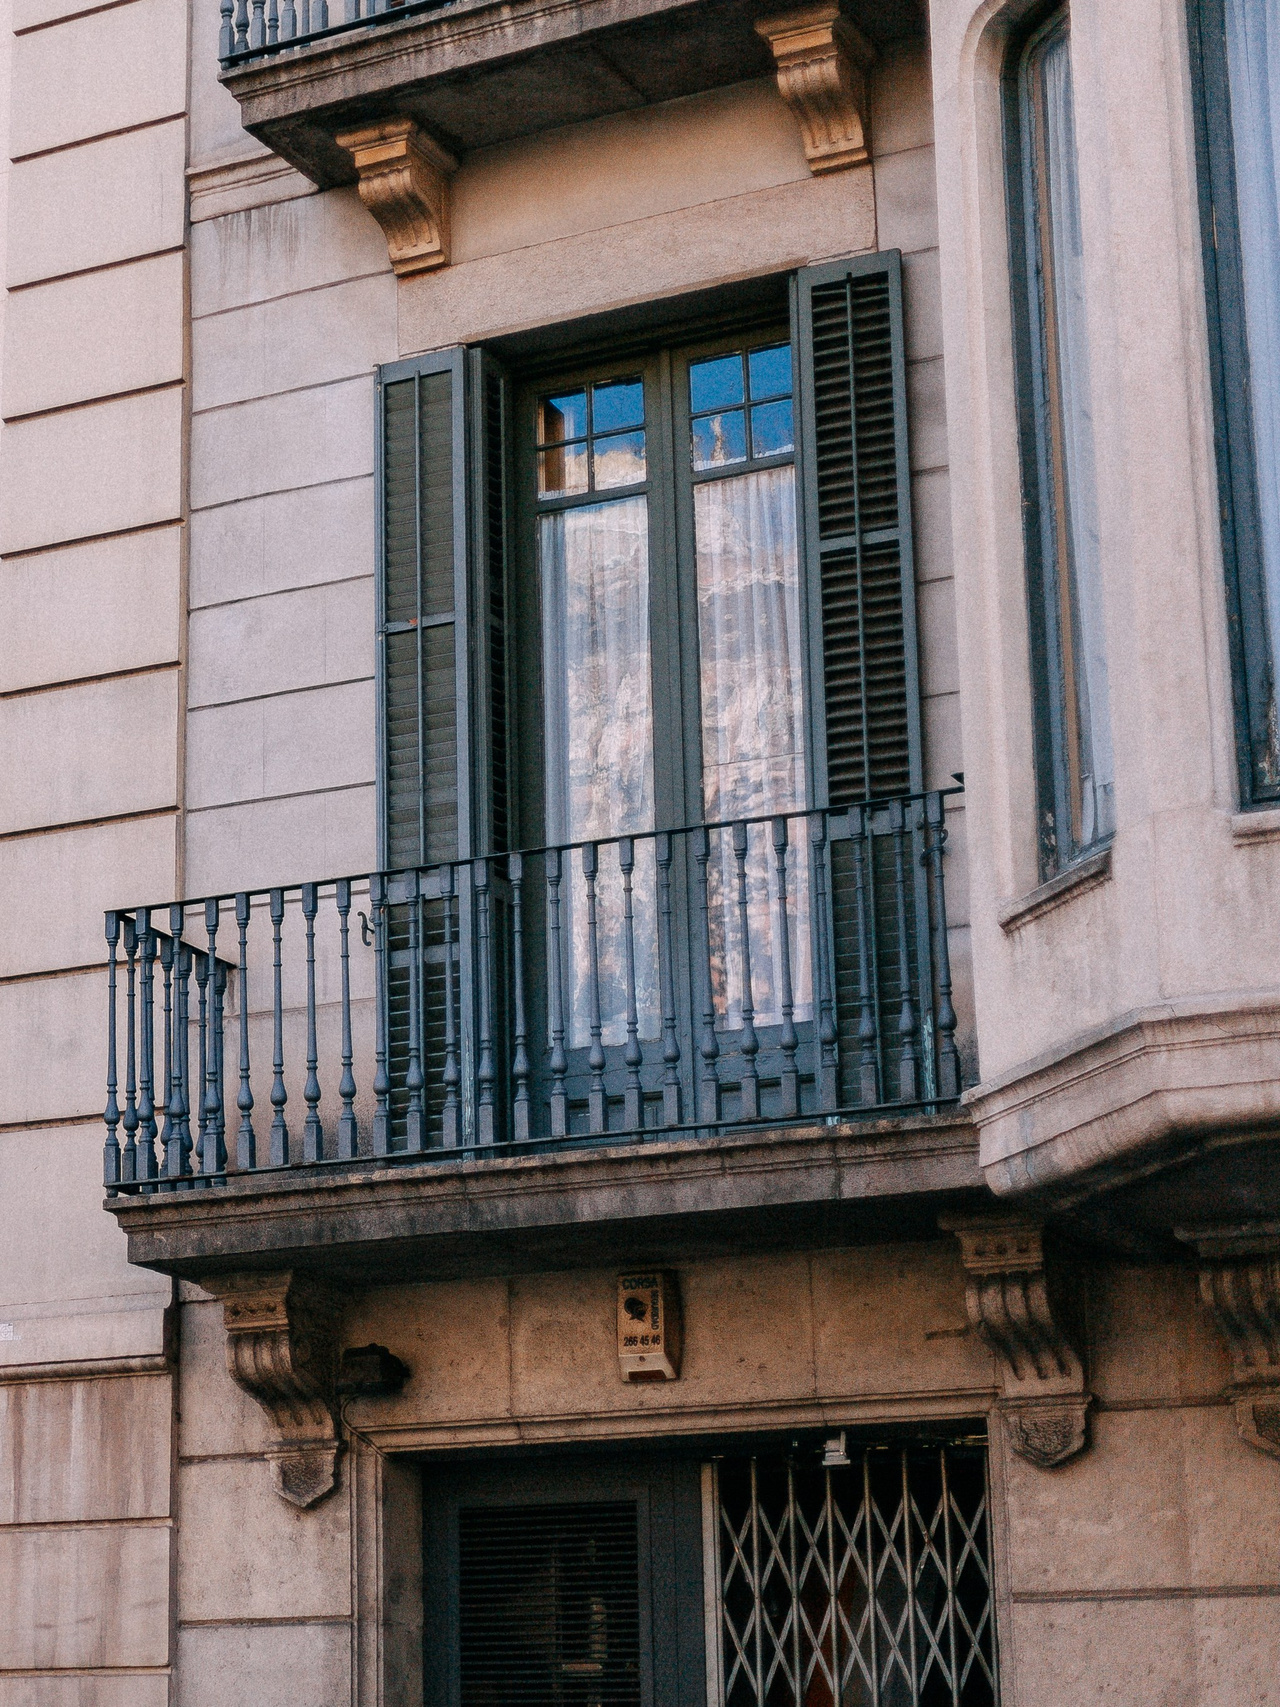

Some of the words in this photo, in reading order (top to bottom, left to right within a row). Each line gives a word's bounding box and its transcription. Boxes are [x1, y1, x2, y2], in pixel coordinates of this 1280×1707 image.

[622, 1278, 658, 1290] CORSA
[624, 1336, 638, 1347] 266
[640, 1335, 650, 1346] 45
[651, 1334, 661, 1345] 46
